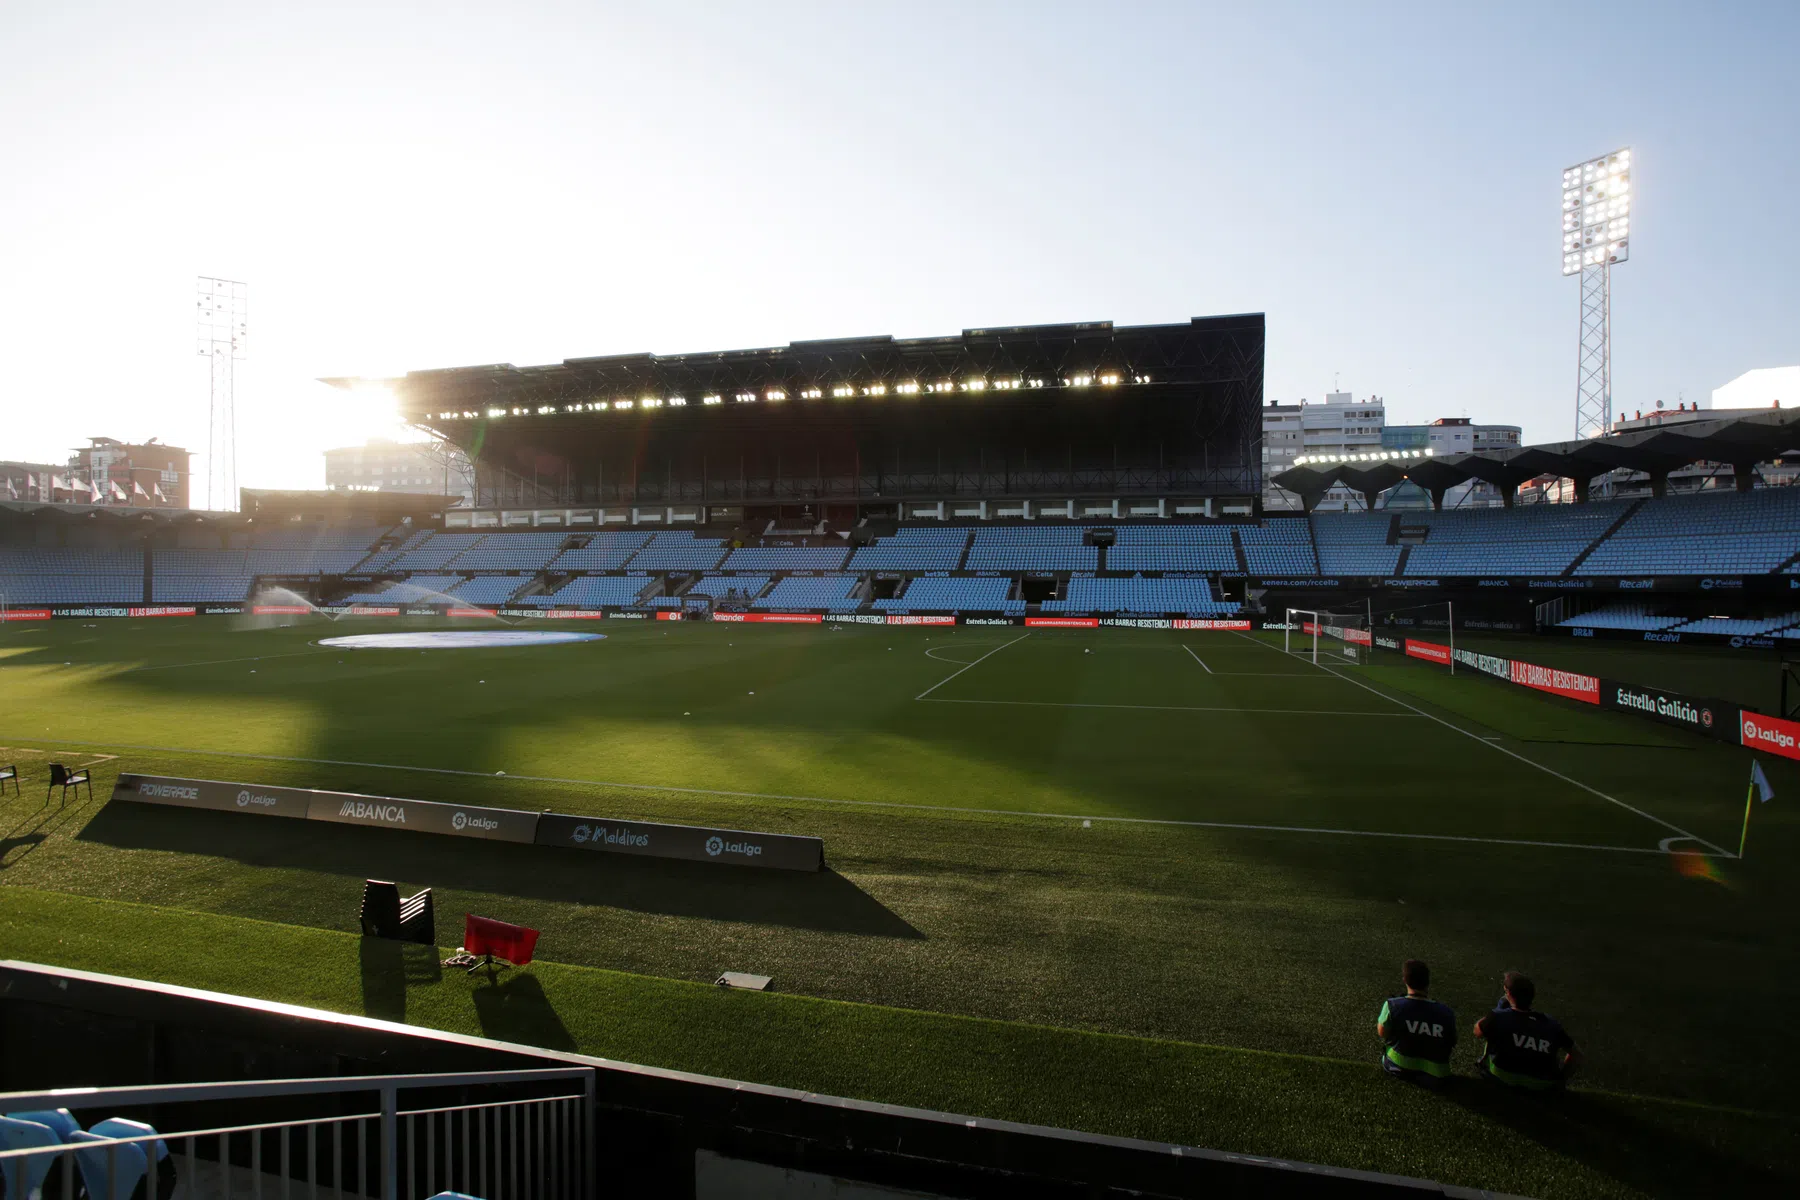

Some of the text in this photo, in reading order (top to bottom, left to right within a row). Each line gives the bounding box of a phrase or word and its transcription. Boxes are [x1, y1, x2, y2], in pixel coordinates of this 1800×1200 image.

[1261, 579, 1339, 587] xenera.com/rccelta
[135, 609, 145, 617] LAS
[146, 608, 166, 616] BARRAS
[712, 612, 745, 621] Santander
[903, 616, 922, 624] BARRAS
[1115, 619, 1136, 627] BARRAS
[1173, 620, 1178, 629] A
[1178, 620, 1189, 629] LAS
[1190, 620, 1212, 629] BARRAS
[1461, 650, 1478, 669] BARRAS
[1511, 660, 1598, 693] A LAS BARRAS RESISTENCIA!
[1616, 688, 1699, 724] Estrella Galicia
[1757, 726, 1795, 748] LaLiga
[139, 783, 199, 800] POWERADE
[250, 794, 277, 806] LaLiga
[467, 818, 498, 832] LaLiga
[592, 826, 649, 847] Maldives
[725, 841, 762, 856] LaLiga
[1405, 1020, 1444, 1039] VAR
[1512, 1033, 1552, 1055] VAR
